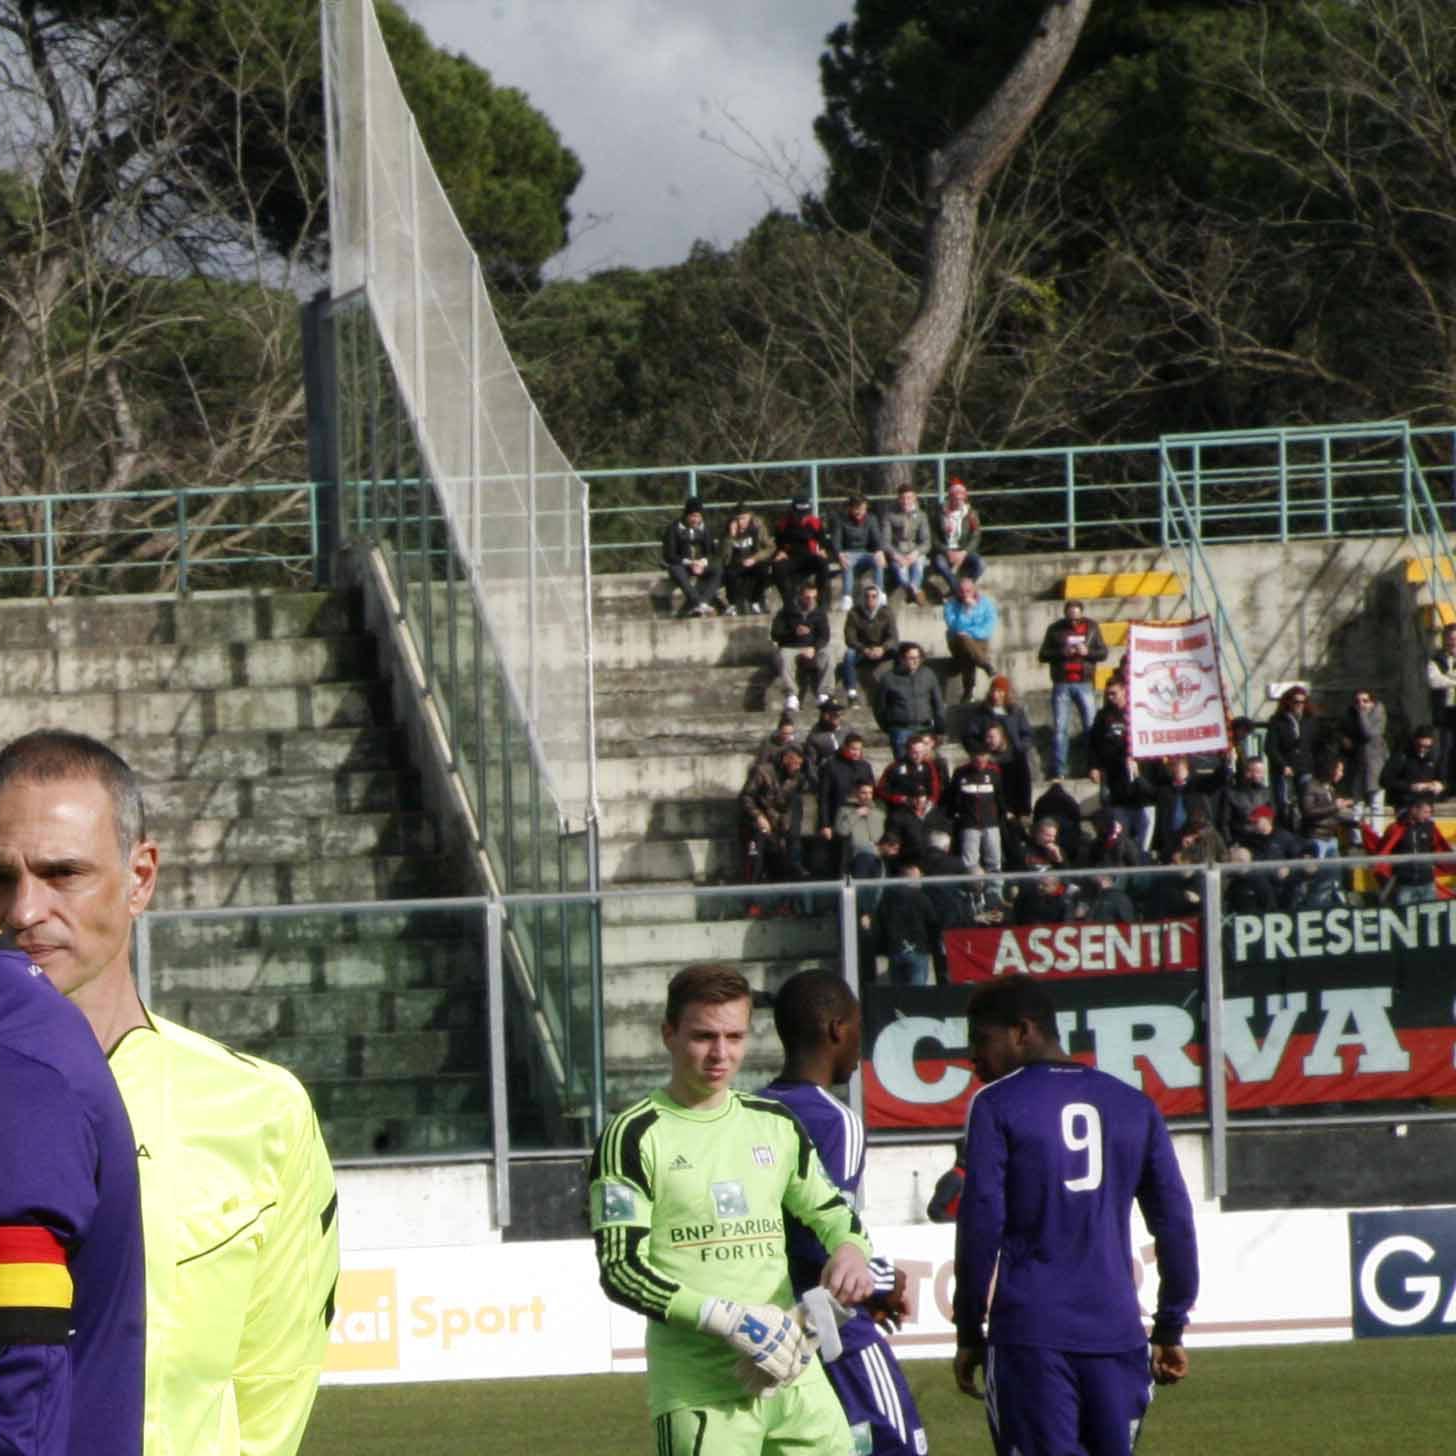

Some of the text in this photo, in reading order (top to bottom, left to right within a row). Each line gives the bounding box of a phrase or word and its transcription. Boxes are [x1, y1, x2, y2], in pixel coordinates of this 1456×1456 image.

[992, 921, 1186, 977] ASSENTI
[873, 987, 1411, 1104] CRVA
[1060, 1102, 1103, 1192] 9
[671, 1218, 784, 1243] BNP PARIBAS
[700, 1243, 776, 1262] FORTIS
[409, 1296, 547, 1351] Sport
